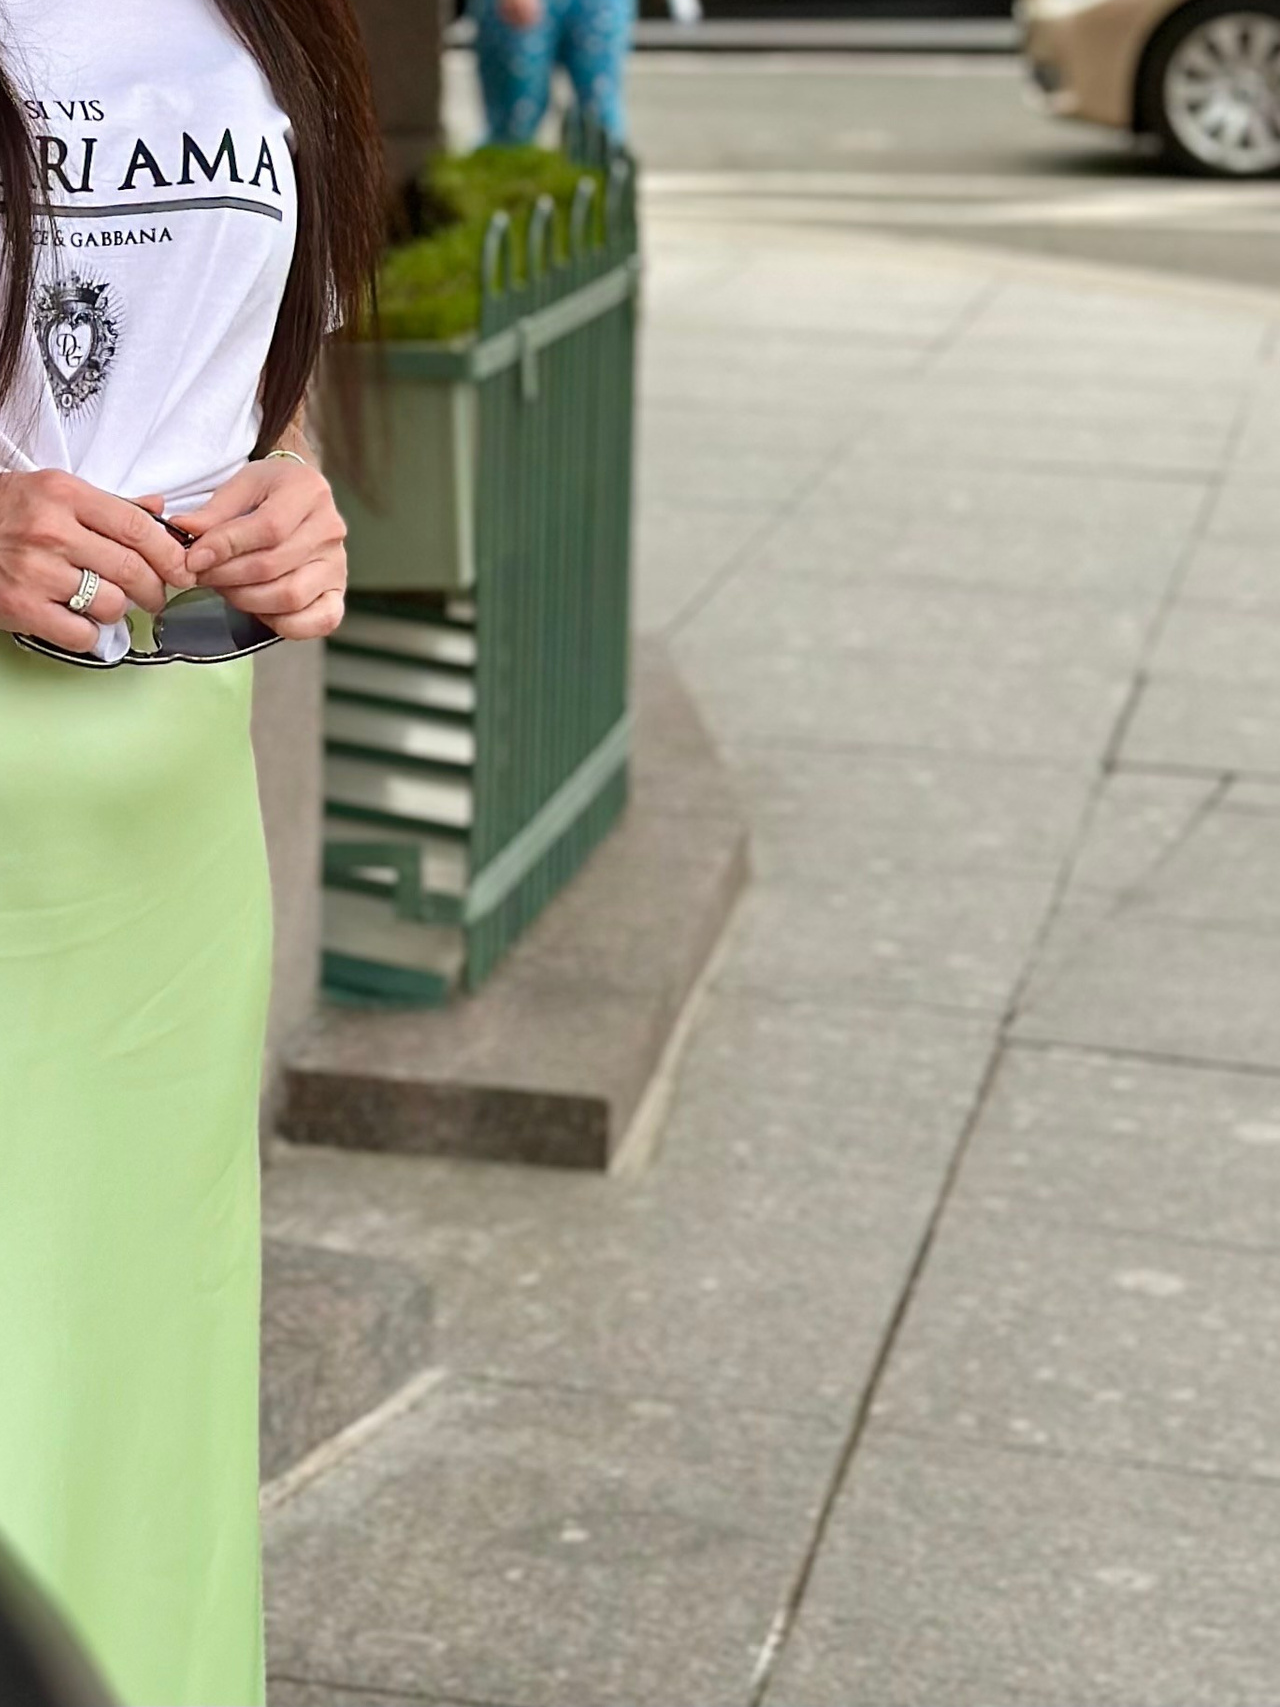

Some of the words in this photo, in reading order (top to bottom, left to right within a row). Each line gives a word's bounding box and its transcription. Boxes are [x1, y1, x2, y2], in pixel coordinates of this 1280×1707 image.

[23, 99, 51, 120] SI
[52, 99, 105, 122] VIS
[117, 127, 282, 196] AMA
[70, 227, 174, 248] GABBANA
